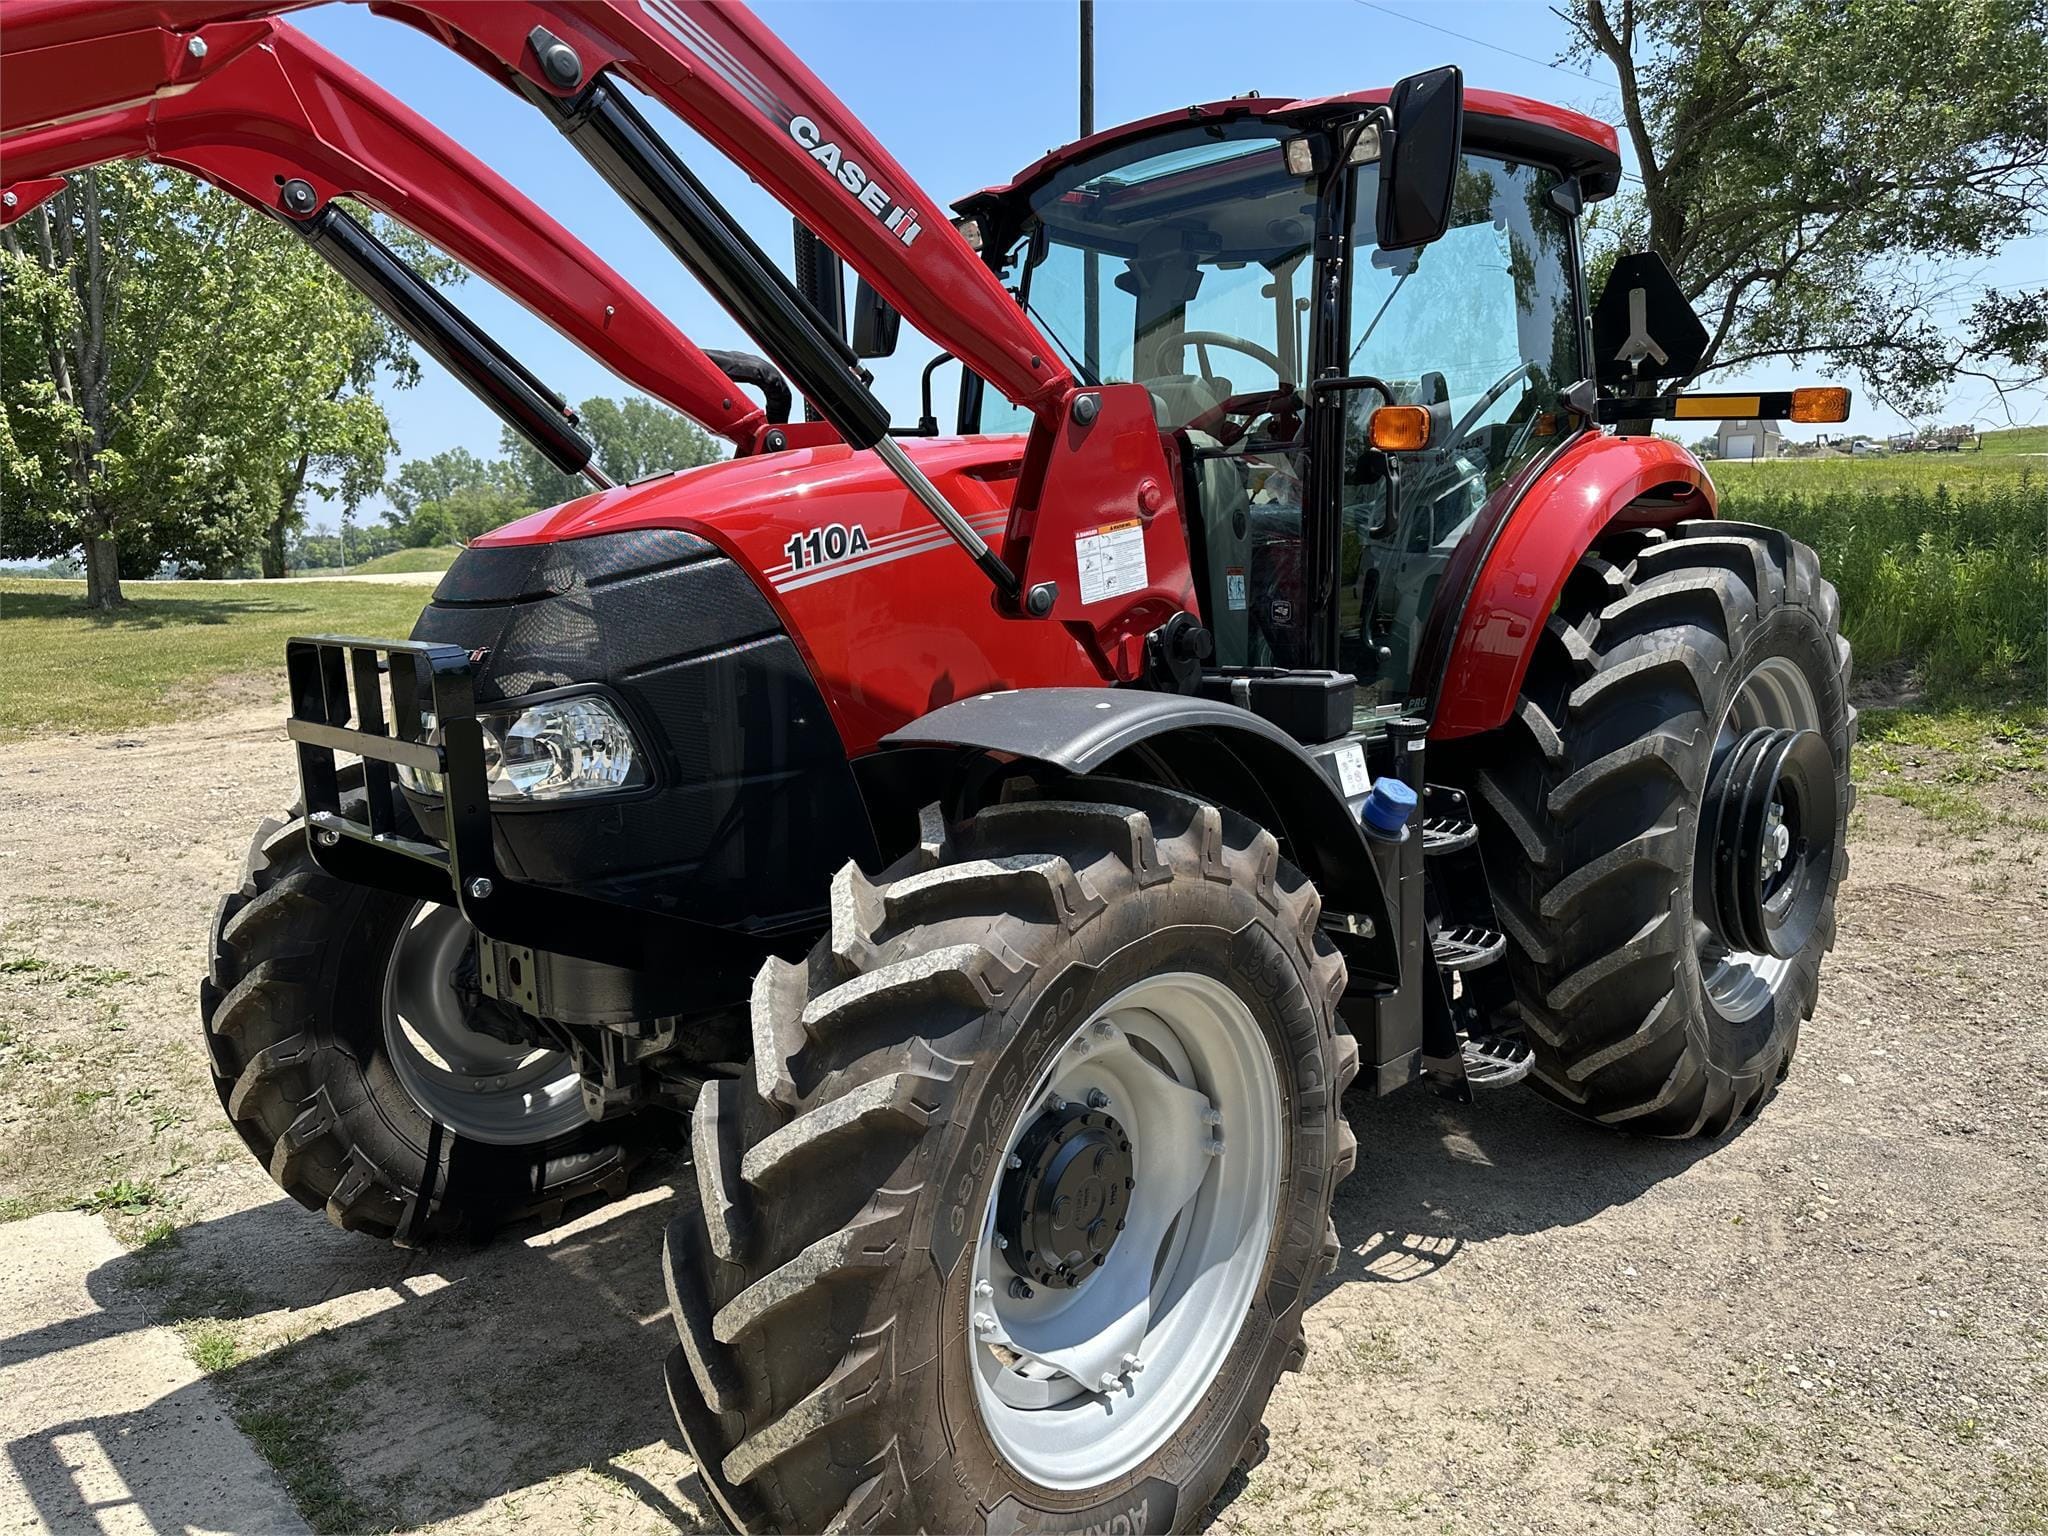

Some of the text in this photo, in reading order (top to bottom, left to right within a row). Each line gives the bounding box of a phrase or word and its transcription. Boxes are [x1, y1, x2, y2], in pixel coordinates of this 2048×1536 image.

[789, 115, 892, 216] CASE
[785, 523, 872, 571] 110A
[1270, 983, 1326, 1288] MICHELIN
